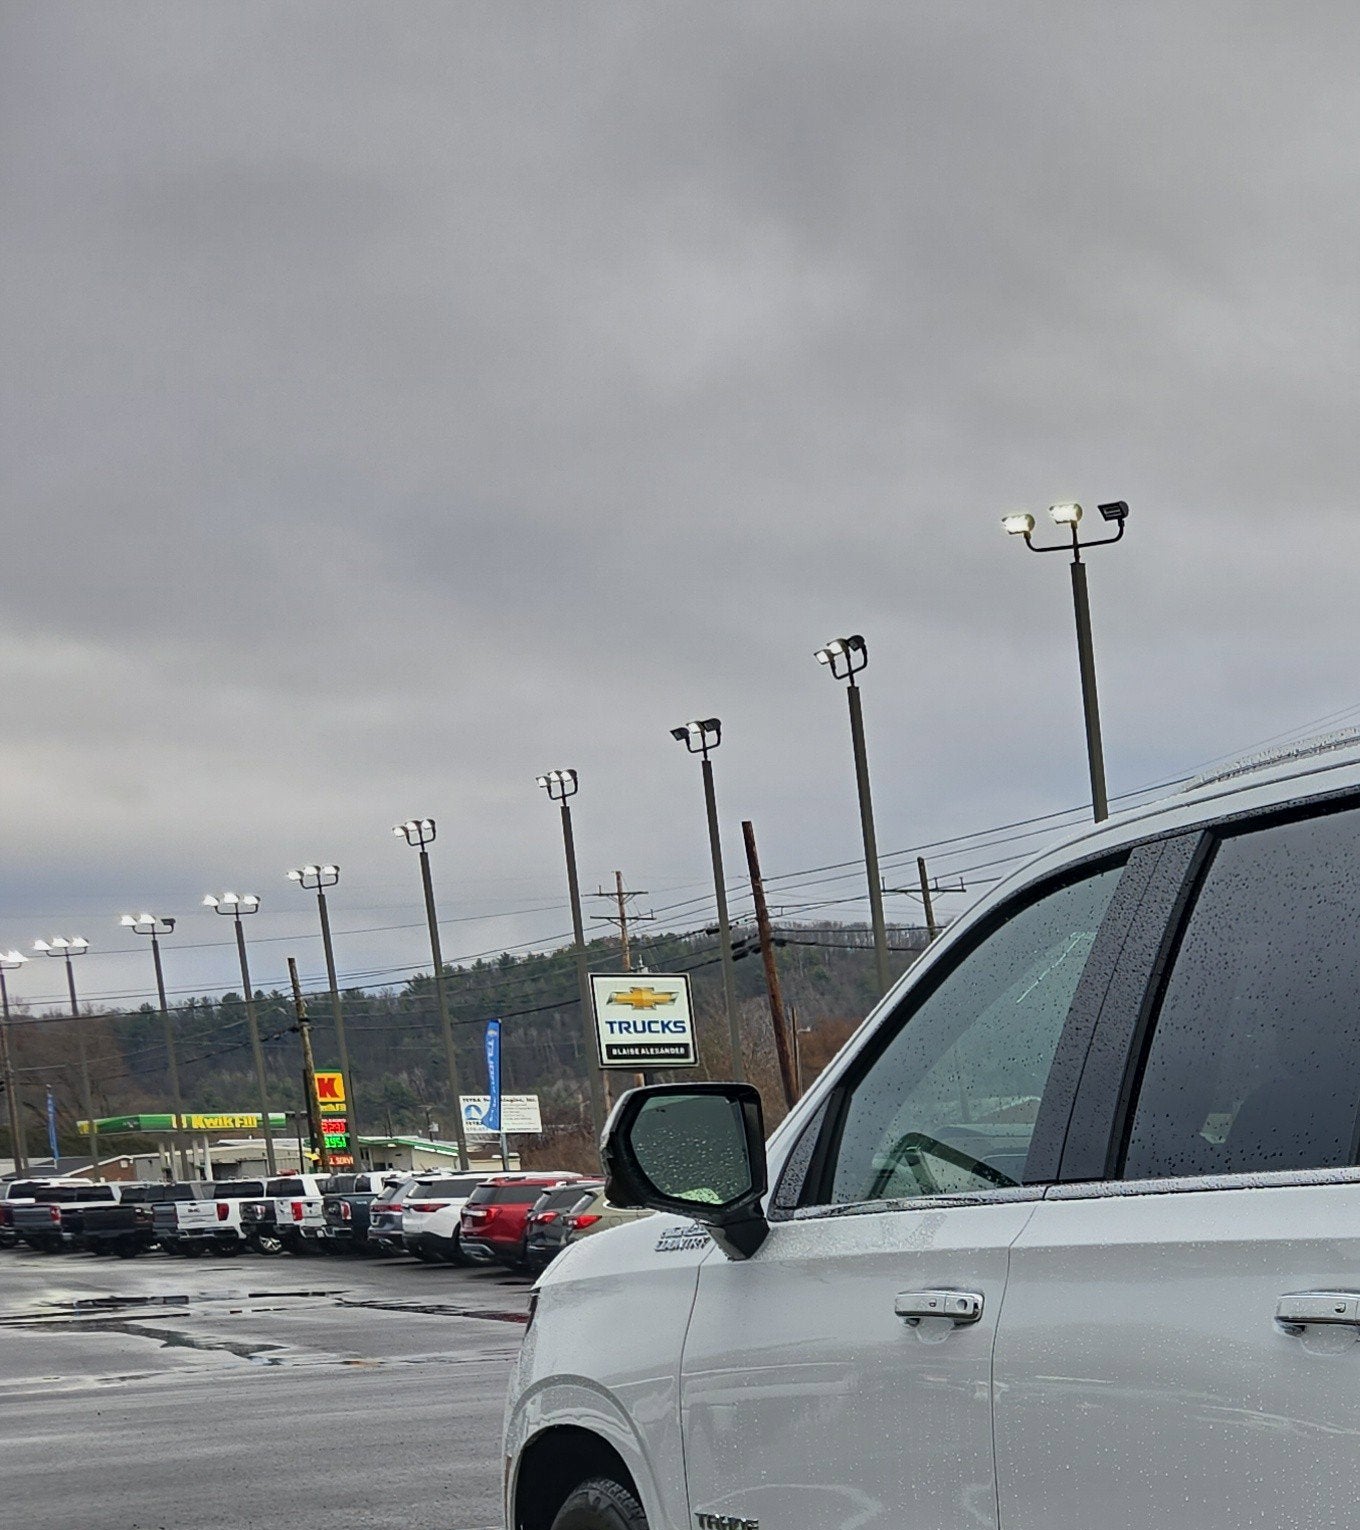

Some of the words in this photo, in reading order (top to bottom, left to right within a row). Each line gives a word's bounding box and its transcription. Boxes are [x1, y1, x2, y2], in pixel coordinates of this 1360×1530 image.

[605, 1020, 687, 1034] TRUCKS
[612, 1047, 639, 1056] BLAISE
[640, 1046, 685, 1056] ALEXANDER
[317, 1077, 340, 1098] K
[192, 1115, 234, 1129] Kwik
[235, 1115, 257, 1128] Fill
